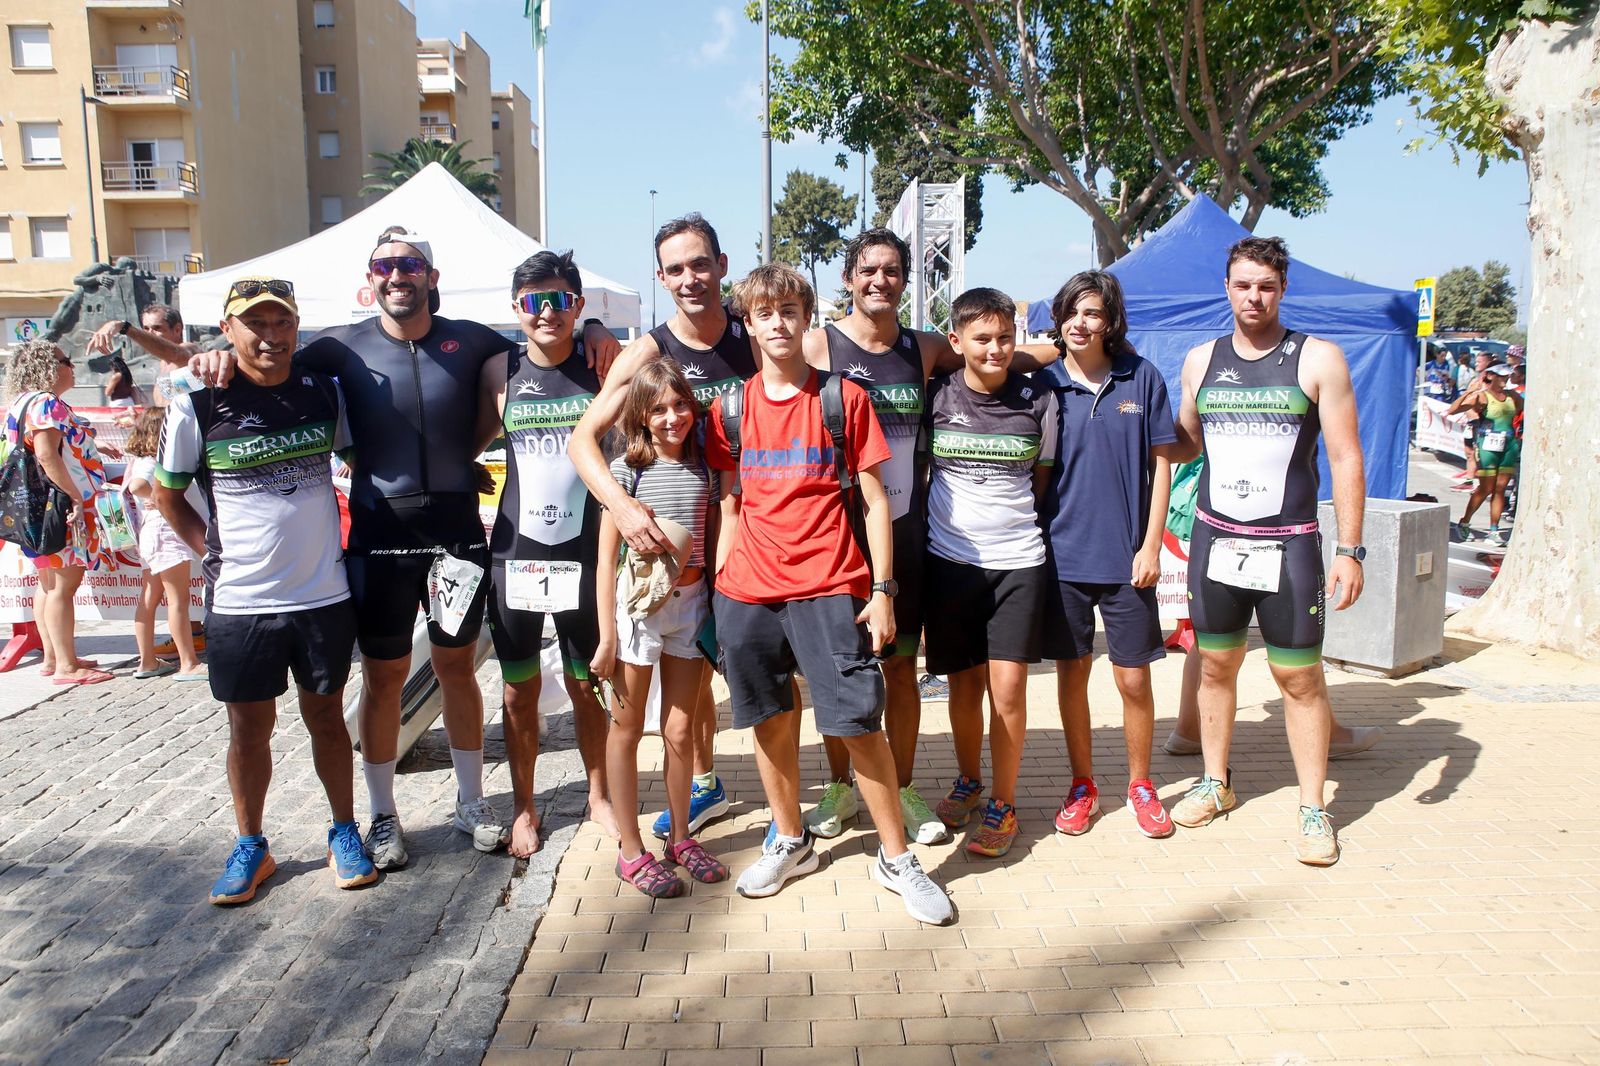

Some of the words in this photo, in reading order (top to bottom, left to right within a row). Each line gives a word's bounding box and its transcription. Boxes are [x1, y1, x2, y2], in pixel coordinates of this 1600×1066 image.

[1205, 389, 1291, 402] SERMAN
[513, 417, 551, 427] TRIATLON
[553, 413, 584, 423] MARBE
[1206, 421, 1292, 436] SABORIDO
[227, 426, 327, 457] SERMAN
[937, 434, 1025, 450] SERMAN
[231, 450, 281, 466] TRIATLON
[283, 441, 328, 455] MARBELLA
[936, 446, 976, 455] TRIATLON
[248, 470, 322, 490] MARBELLA
[1220, 483, 1268, 493] MARBELLA
[528, 509, 573, 518] MARBELLA
[1236, 552, 1250, 572] 7
[437, 576, 460, 609] 24
[538, 576, 549, 596] 1
[15, 595, 34, 609] Roq
[74, 593, 99, 606] lustre
[101, 593, 139, 608] Ayuntami
